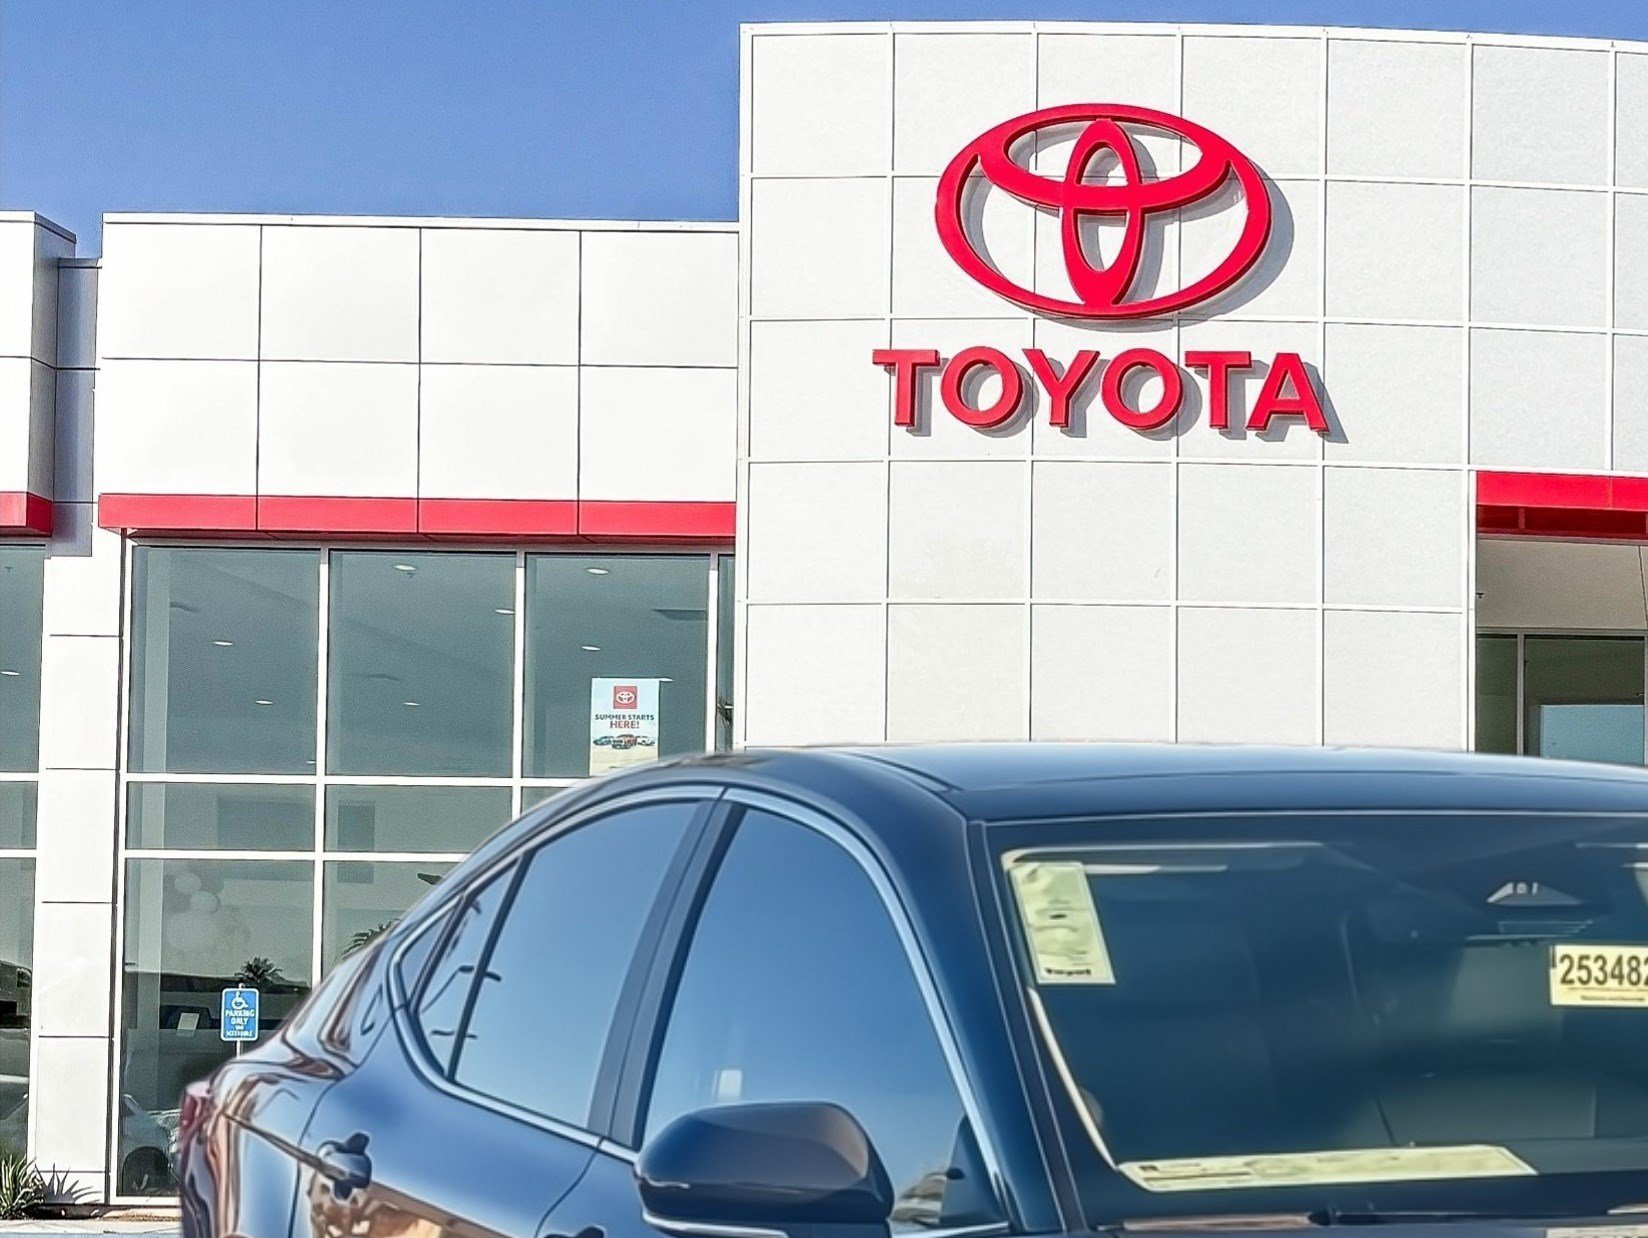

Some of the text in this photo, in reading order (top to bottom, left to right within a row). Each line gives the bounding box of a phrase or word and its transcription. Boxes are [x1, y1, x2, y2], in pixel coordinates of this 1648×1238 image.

[873, 346, 1328, 433] TOYOTA
[610, 721, 640, 729] HERE!
[226, 1009, 255, 1017] PARKING
